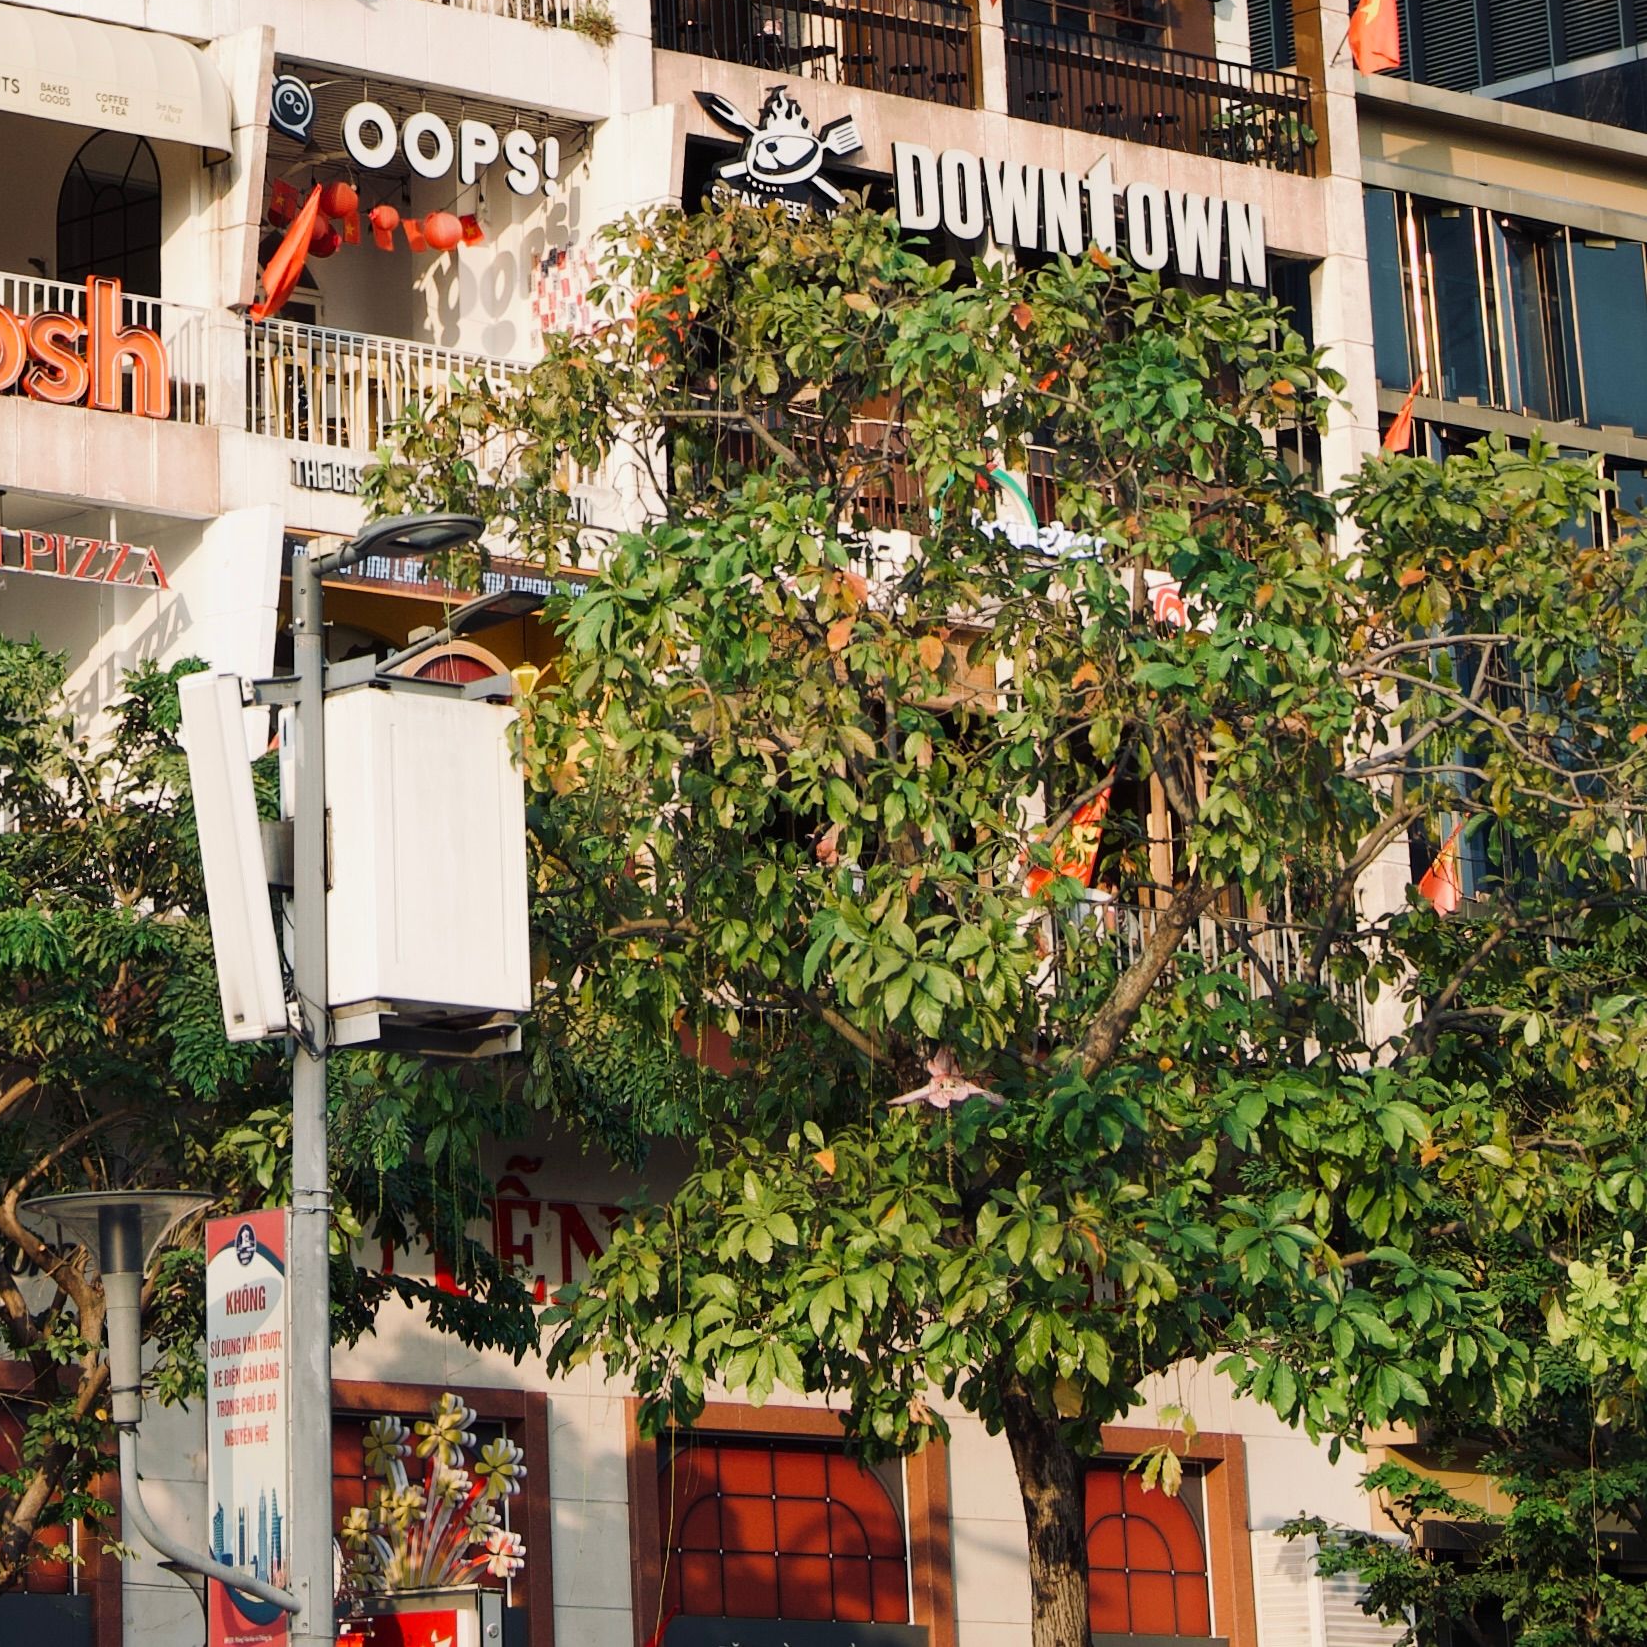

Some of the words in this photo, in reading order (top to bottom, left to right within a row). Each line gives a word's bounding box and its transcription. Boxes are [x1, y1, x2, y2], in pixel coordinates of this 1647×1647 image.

[39, 93, 71, 107] GOODS
[111, 106, 127, 117] TEA
[40, 82, 69, 96] BAKED
[96, 92, 129, 106] COFFEE
[342, 101, 559, 197] OOPS!
[290, 457, 331, 488] THE
[20, 529, 170, 590] PIZZA
[226, 1284, 266, 1315] KHÔNG
[213, 1370, 223, 1388] XE
[216, 1398, 240, 1418] TRONG
